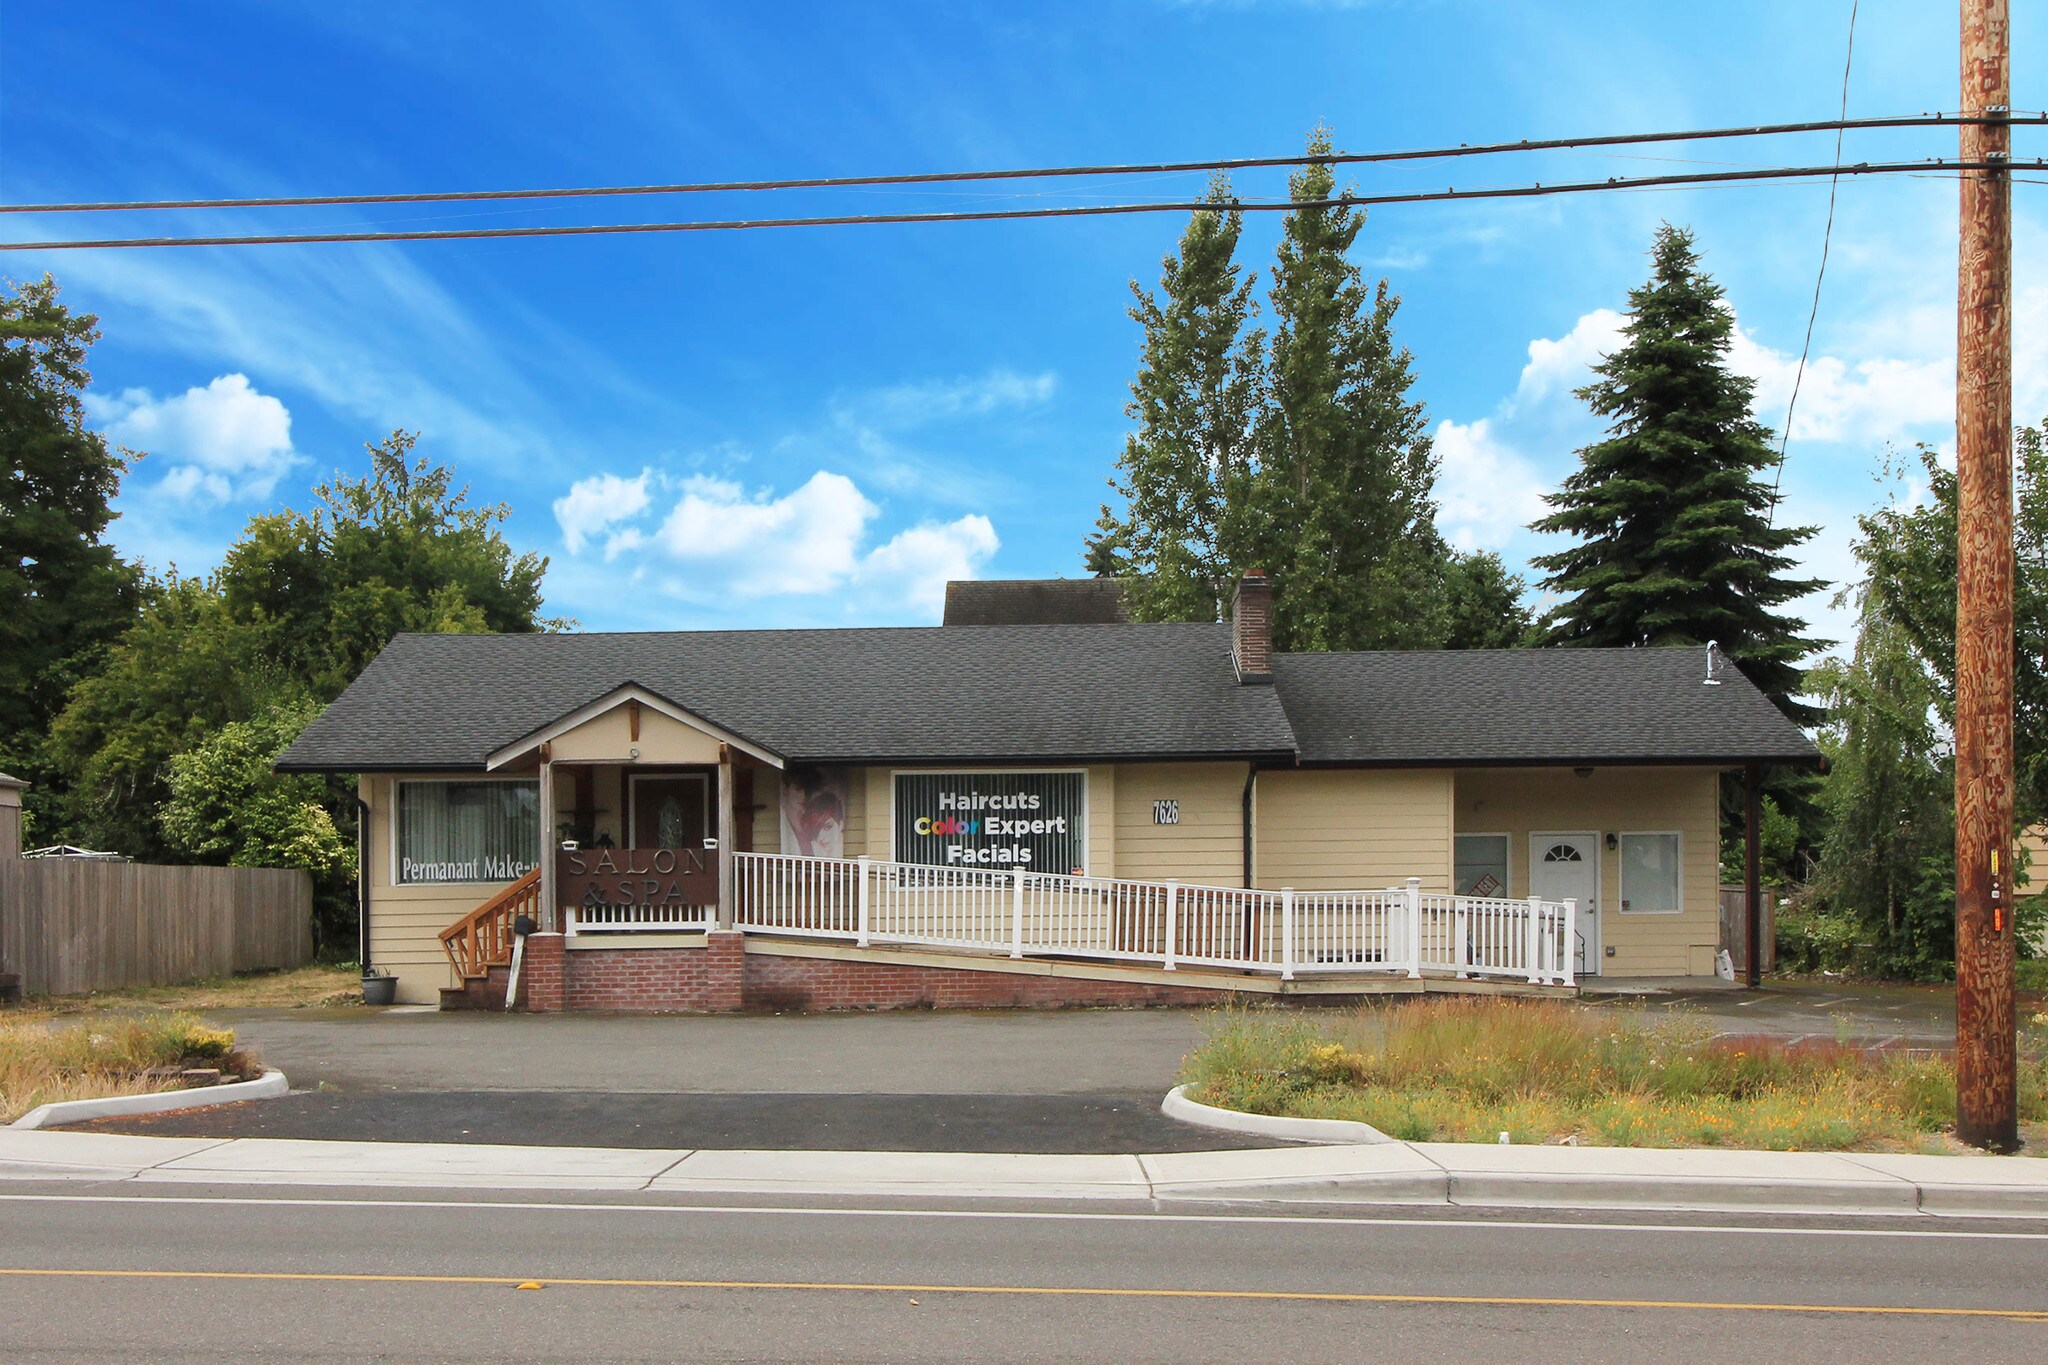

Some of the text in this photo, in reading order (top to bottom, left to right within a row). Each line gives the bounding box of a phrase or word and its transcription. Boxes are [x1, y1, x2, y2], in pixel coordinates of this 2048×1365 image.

[939, 791, 1040, 811] Haircuts
[1153, 800, 1178, 824] 7626
[914, 816, 1066, 838] Color Expert
[569, 849, 706, 876] SALON
[947, 844, 1032, 863] Facials
[402, 857, 478, 880] Permanant
[584, 880, 688, 906] & SPA
